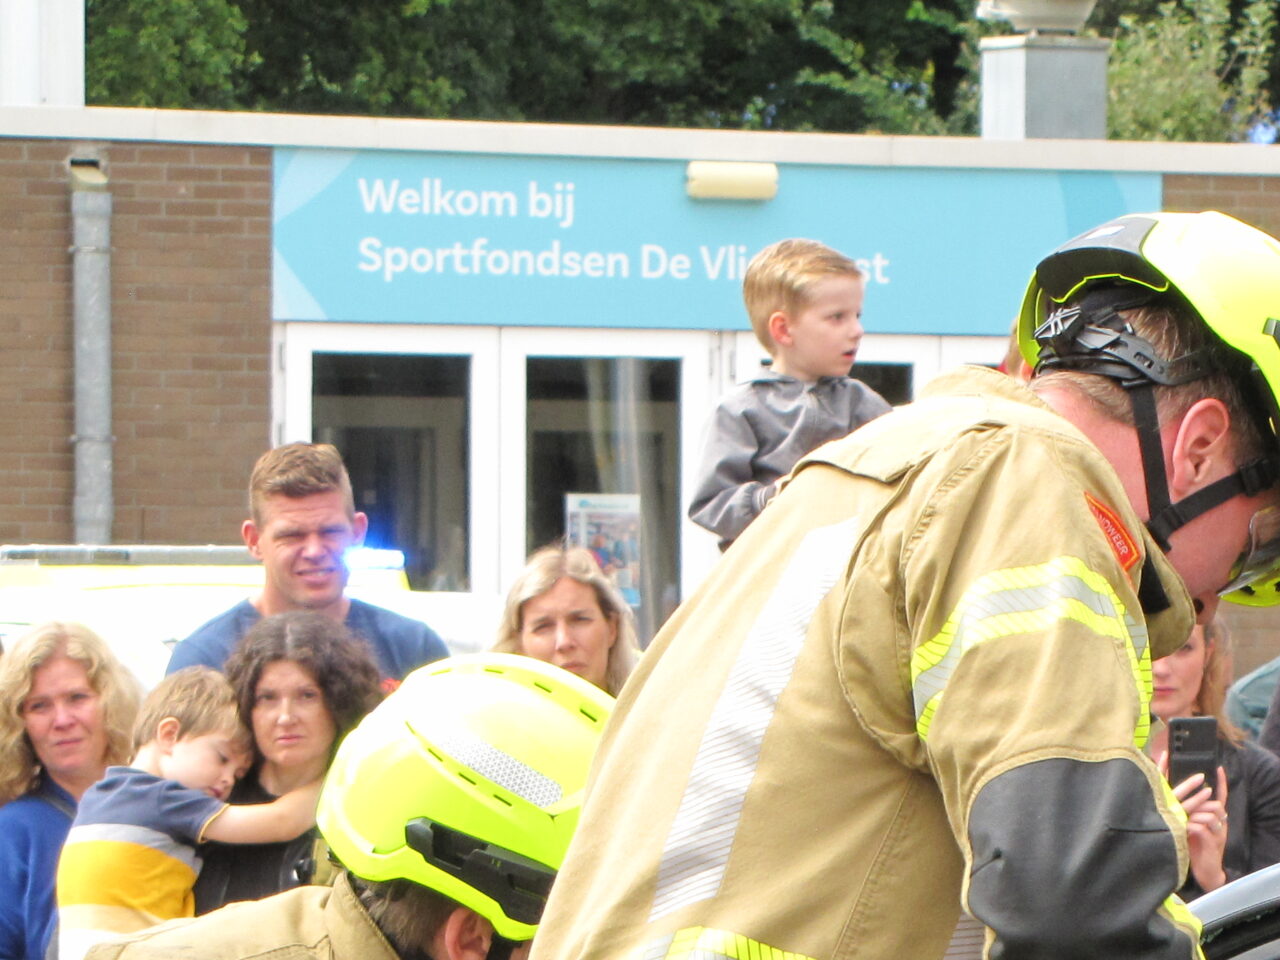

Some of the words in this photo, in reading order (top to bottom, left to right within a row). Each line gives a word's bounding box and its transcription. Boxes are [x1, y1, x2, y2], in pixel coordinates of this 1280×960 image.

[358, 178, 517, 217] Welkom
[528, 181, 575, 228] bij
[358, 237, 629, 283] Sportfondsen
[641, 244, 691, 279] De
[699, 245, 890, 284] Vlist
